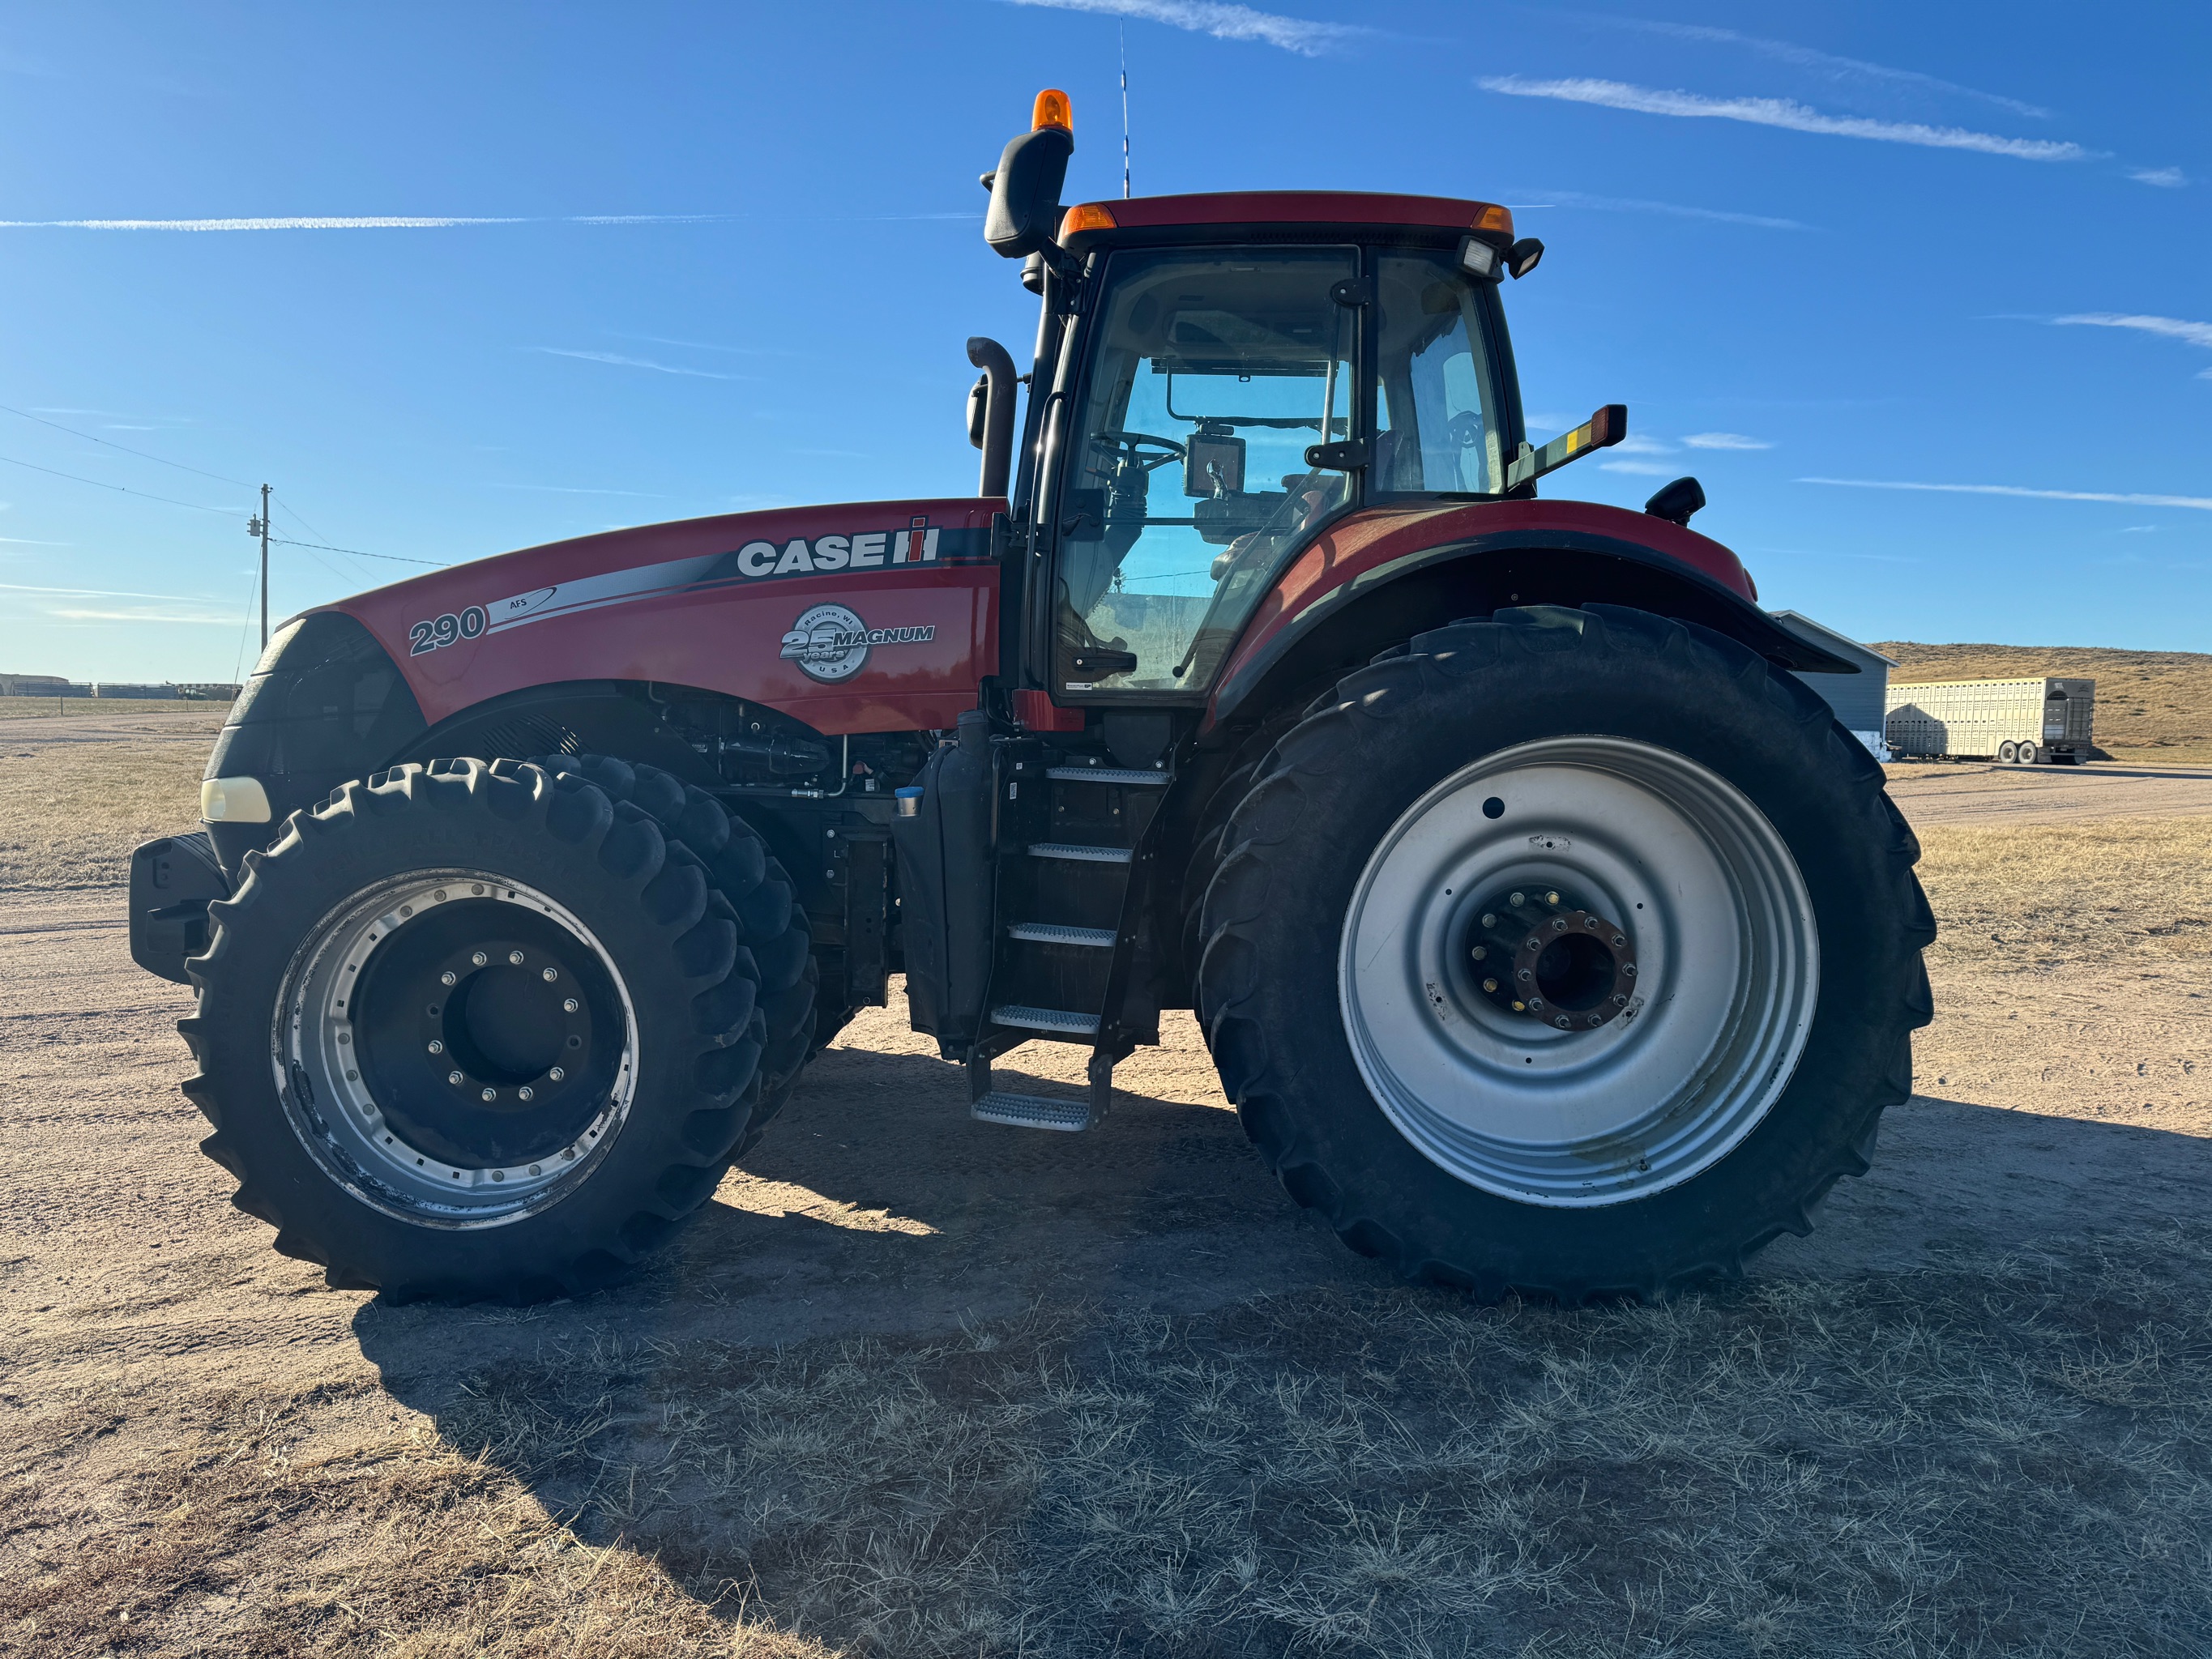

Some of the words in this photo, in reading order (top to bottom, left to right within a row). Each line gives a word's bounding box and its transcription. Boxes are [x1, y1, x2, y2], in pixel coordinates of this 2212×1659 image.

[737, 532, 886, 577] CASE
[510, 598, 527, 610] AFS
[804, 611, 840, 627] Racine,
[843, 614, 854, 625] WI
[408, 605, 486, 658] 290
[833, 625, 936, 647] MAGNUM
[779, 629, 837, 659] 25
[802, 649, 846, 663] years
